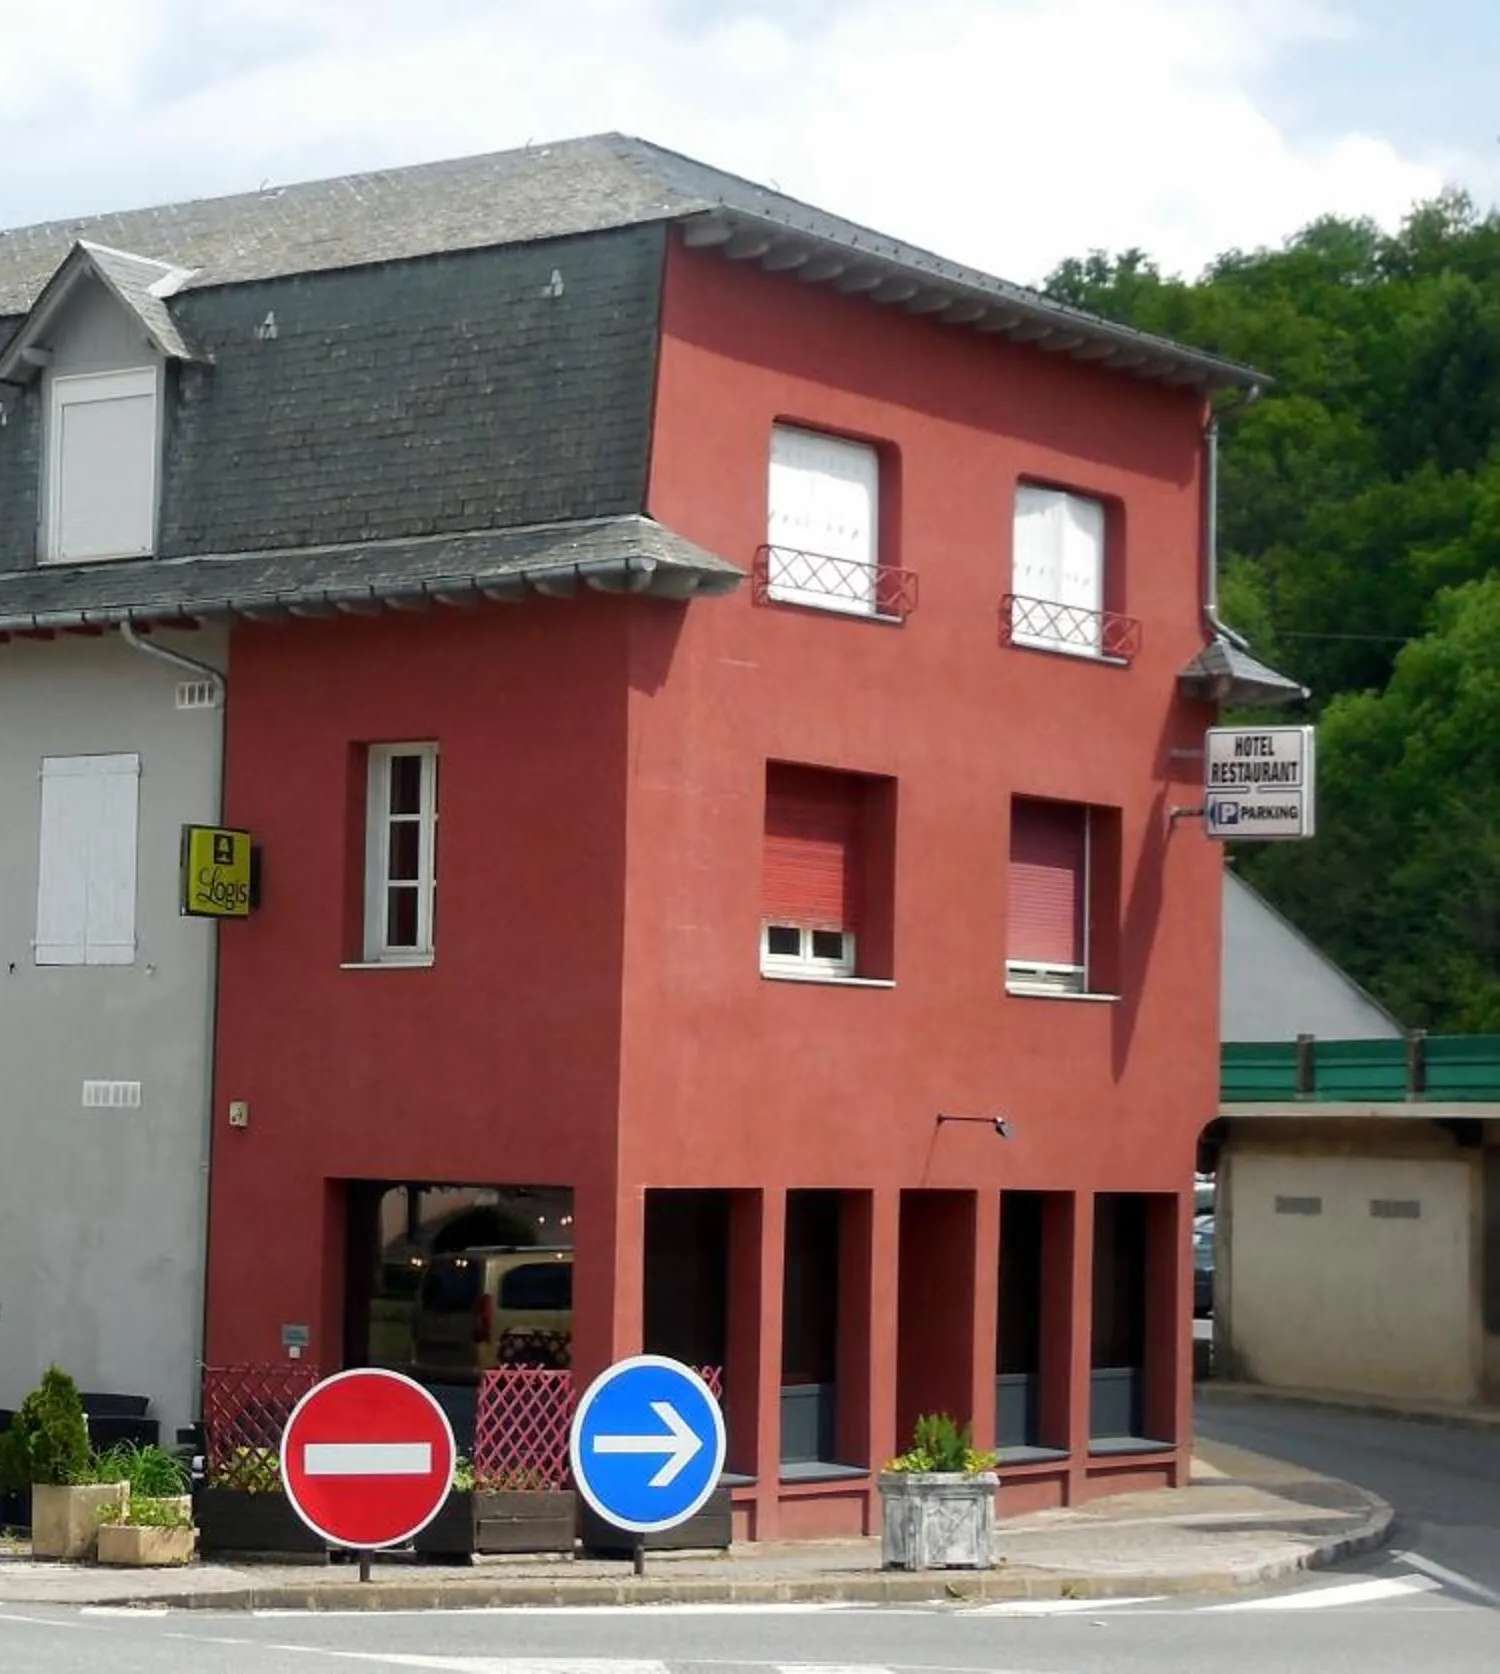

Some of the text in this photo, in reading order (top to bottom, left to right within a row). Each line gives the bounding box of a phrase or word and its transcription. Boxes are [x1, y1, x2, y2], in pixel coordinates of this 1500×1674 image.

[1234, 735, 1275, 756] HOTEL
[1211, 762, 1298, 782] RESTAURANT
[1241, 805, 1298, 819] PARKING
[196, 866, 247, 910] Logis
